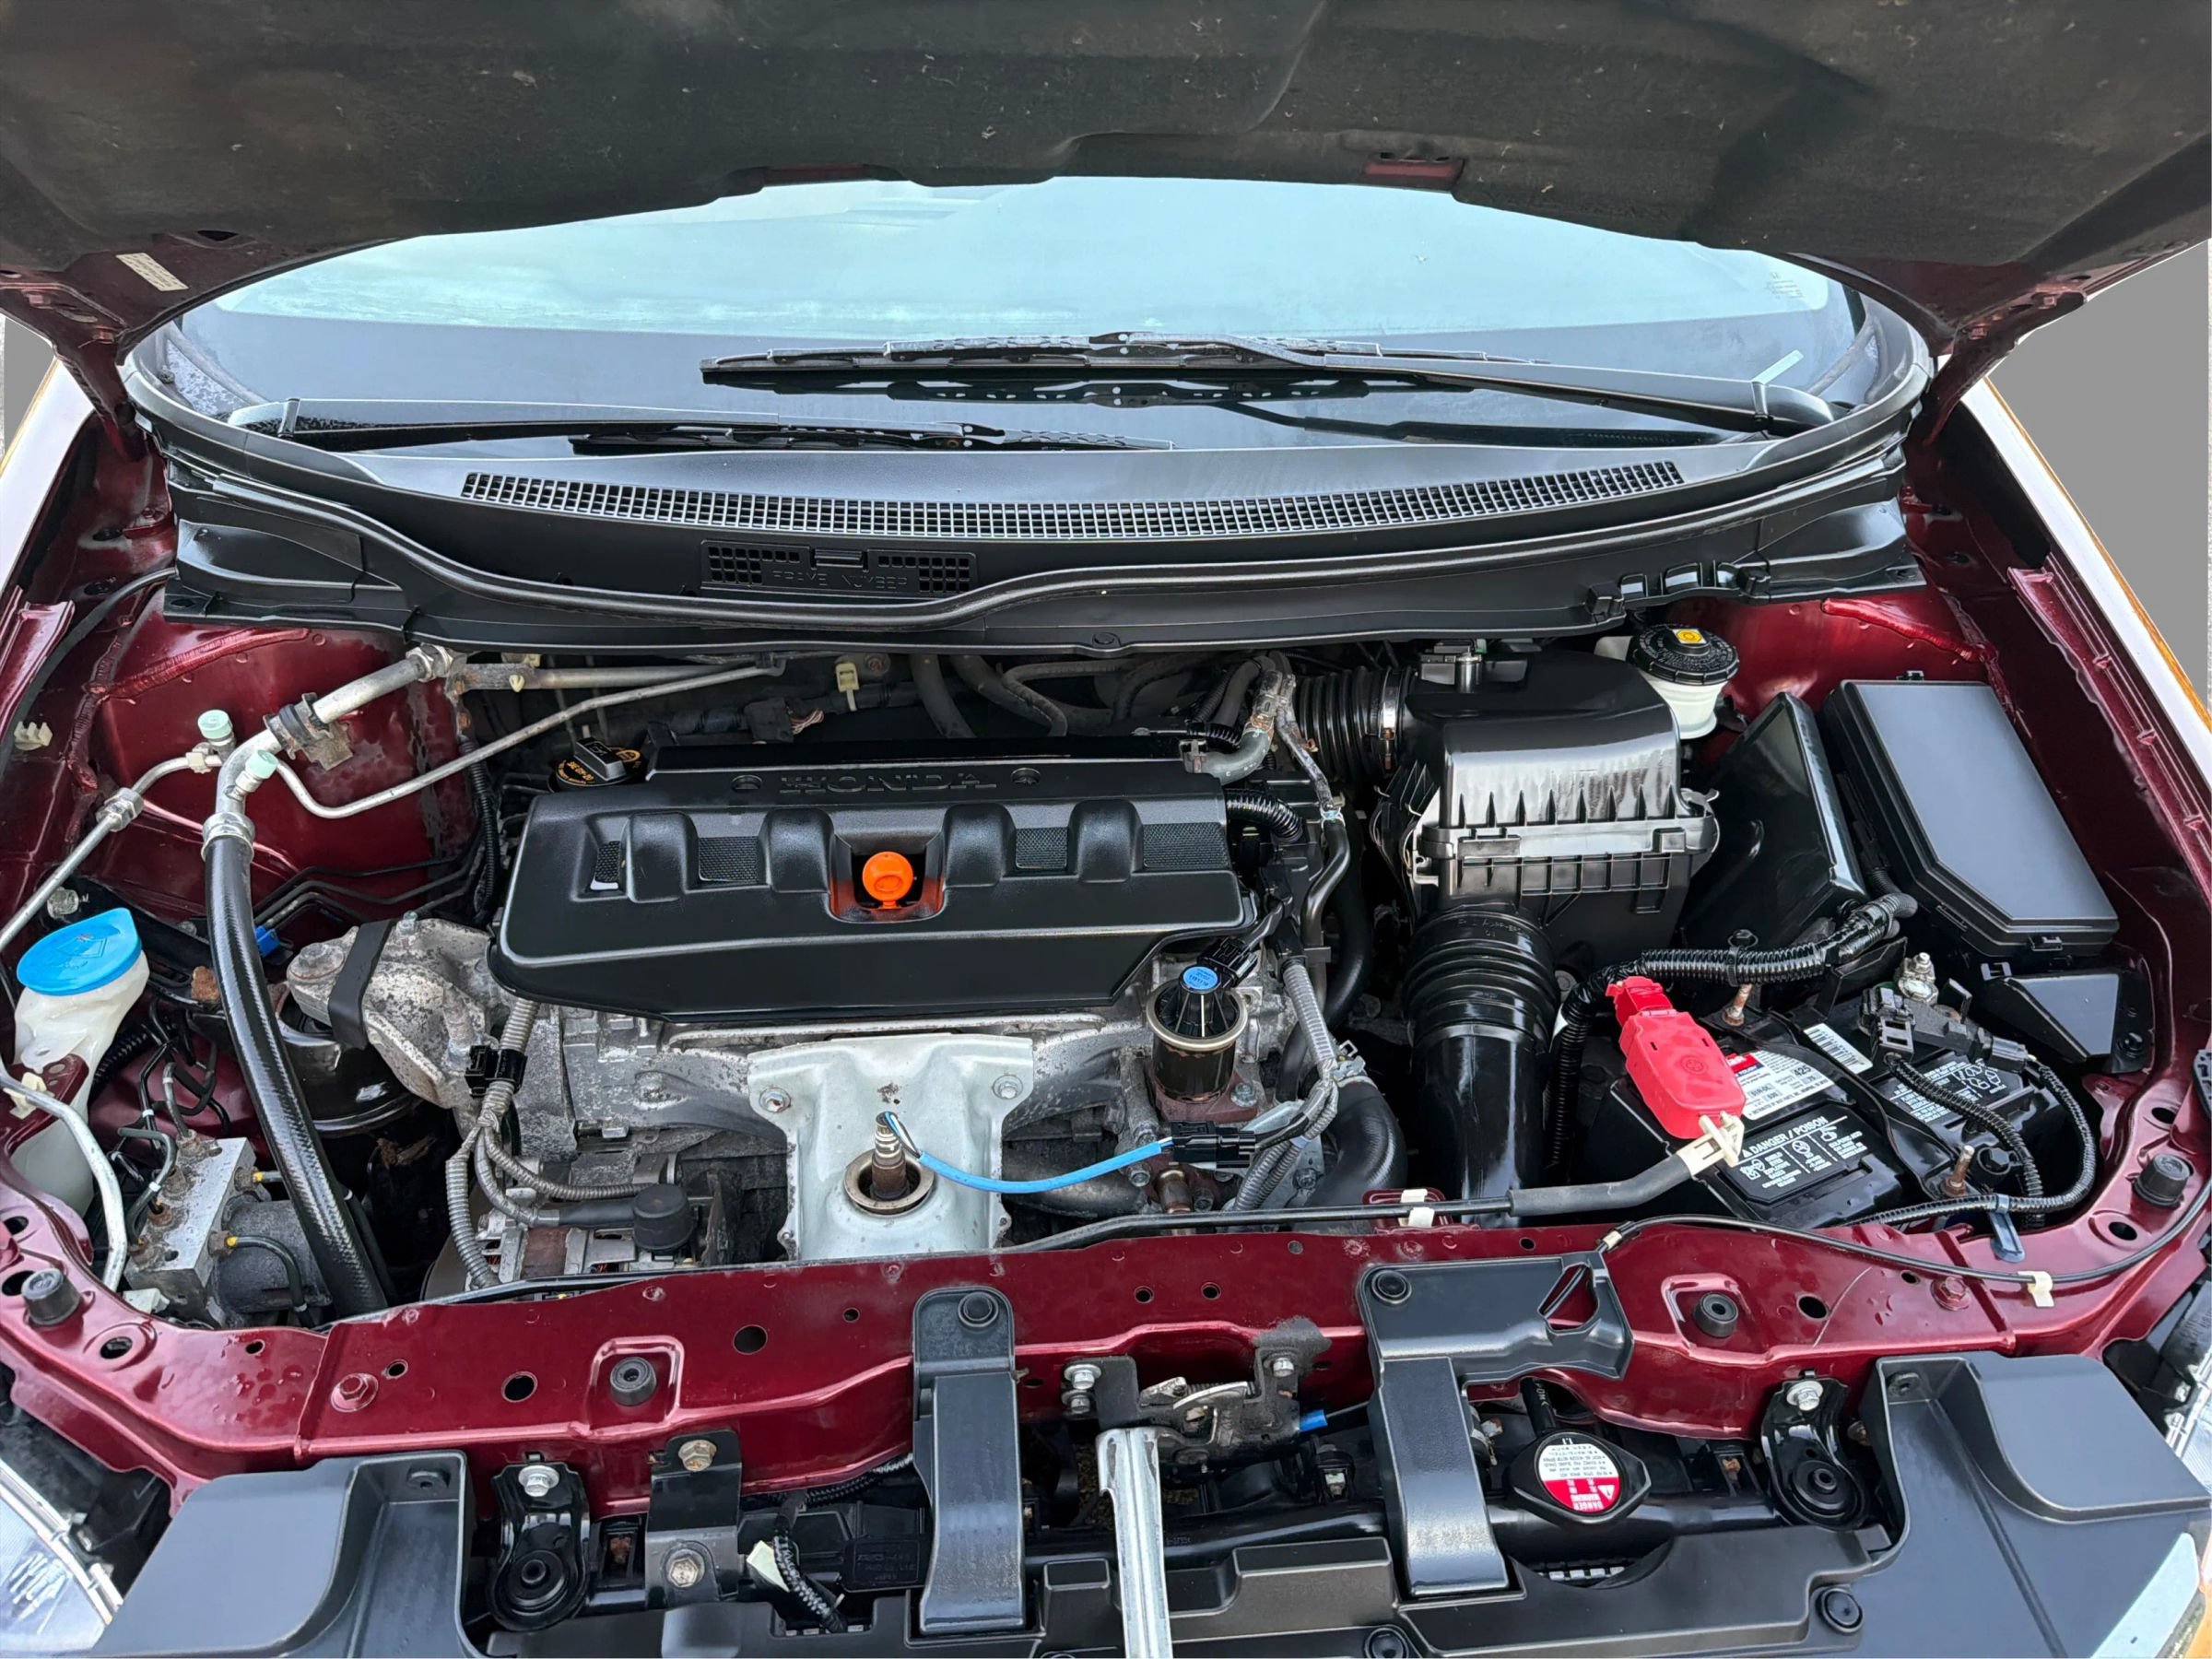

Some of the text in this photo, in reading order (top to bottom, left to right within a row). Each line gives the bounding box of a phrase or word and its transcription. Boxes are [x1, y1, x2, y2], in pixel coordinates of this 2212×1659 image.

[772, 571, 908, 590] FRAME NUMBER
[780, 772, 997, 794] HONDA
[1794, 1065, 1812, 1077] 425
[1749, 1133, 1789, 1155] DANGER
[1792, 1115, 1830, 1135] POISON
[1572, 1500, 1605, 1512] DANGER
